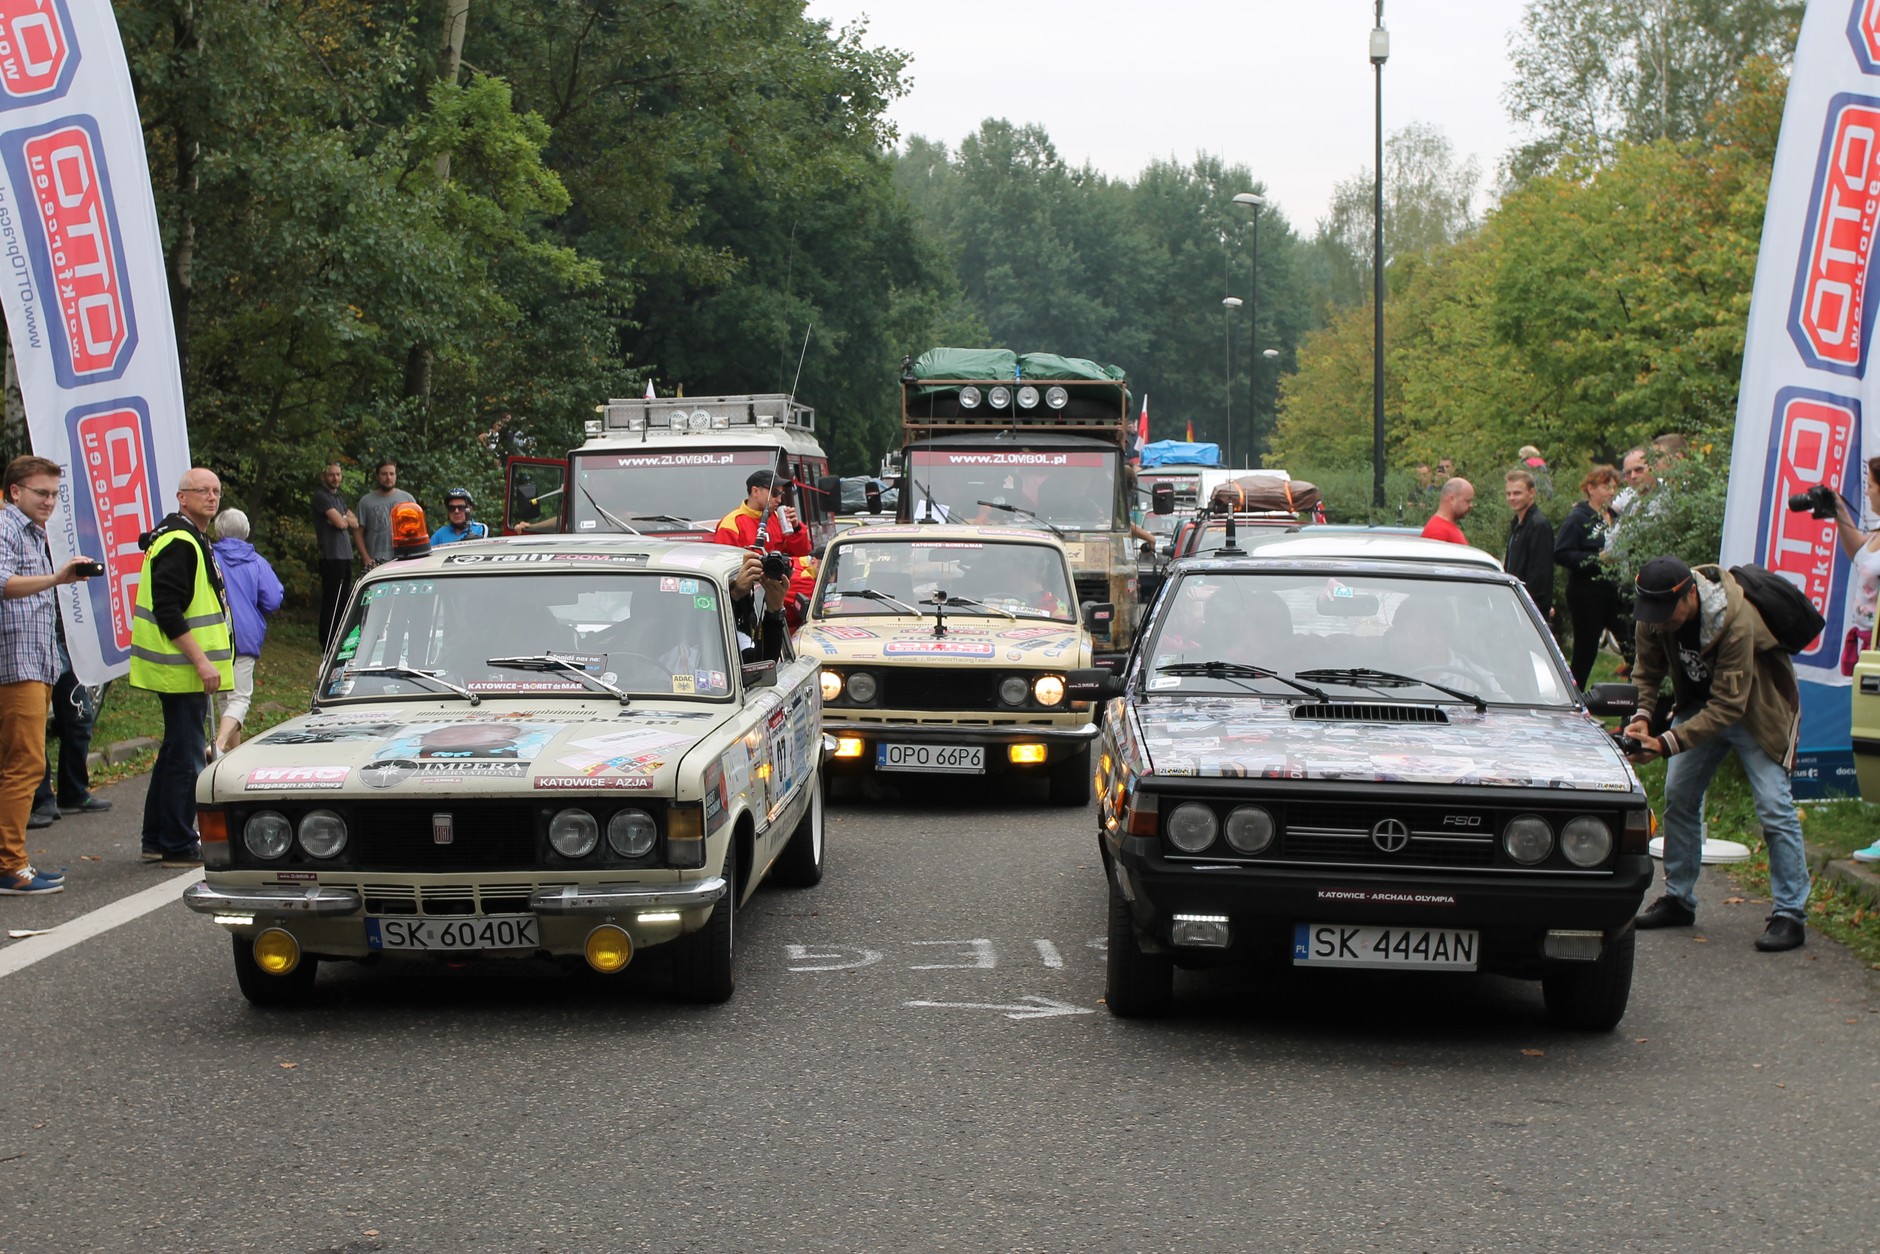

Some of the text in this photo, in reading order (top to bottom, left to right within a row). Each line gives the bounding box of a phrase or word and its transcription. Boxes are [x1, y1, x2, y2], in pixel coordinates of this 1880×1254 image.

[1810, 125, 1875, 345] OTTO
[1850, 154, 1880, 348] workforce.
[618, 454, 734, 466] www.ZLOMBOL.pl
[949, 454, 1067, 465] www.ZLOMBOL.pl
[491, 553, 637, 563] rallyZOOM.com
[1723, 670, 1744, 696] T
[890, 746, 981, 766] OPO 66P6
[422, 762, 522, 770] IMPERA
[540, 778, 605, 786] KATOWICE
[616, 778, 648, 787] AZJA
[1443, 815, 1482, 826] FSO
[436, 826, 450, 841] FIAT
[1318, 891, 1365, 899] KATOWICE
[1371, 893, 1413, 901] ARCHAIA
[1415, 895, 1455, 903] OLYMPIA
[385, 919, 535, 947] SK 6040K
[1295, 945, 1307, 953] PL
[1315, 928, 1474, 962] SK 444AN
